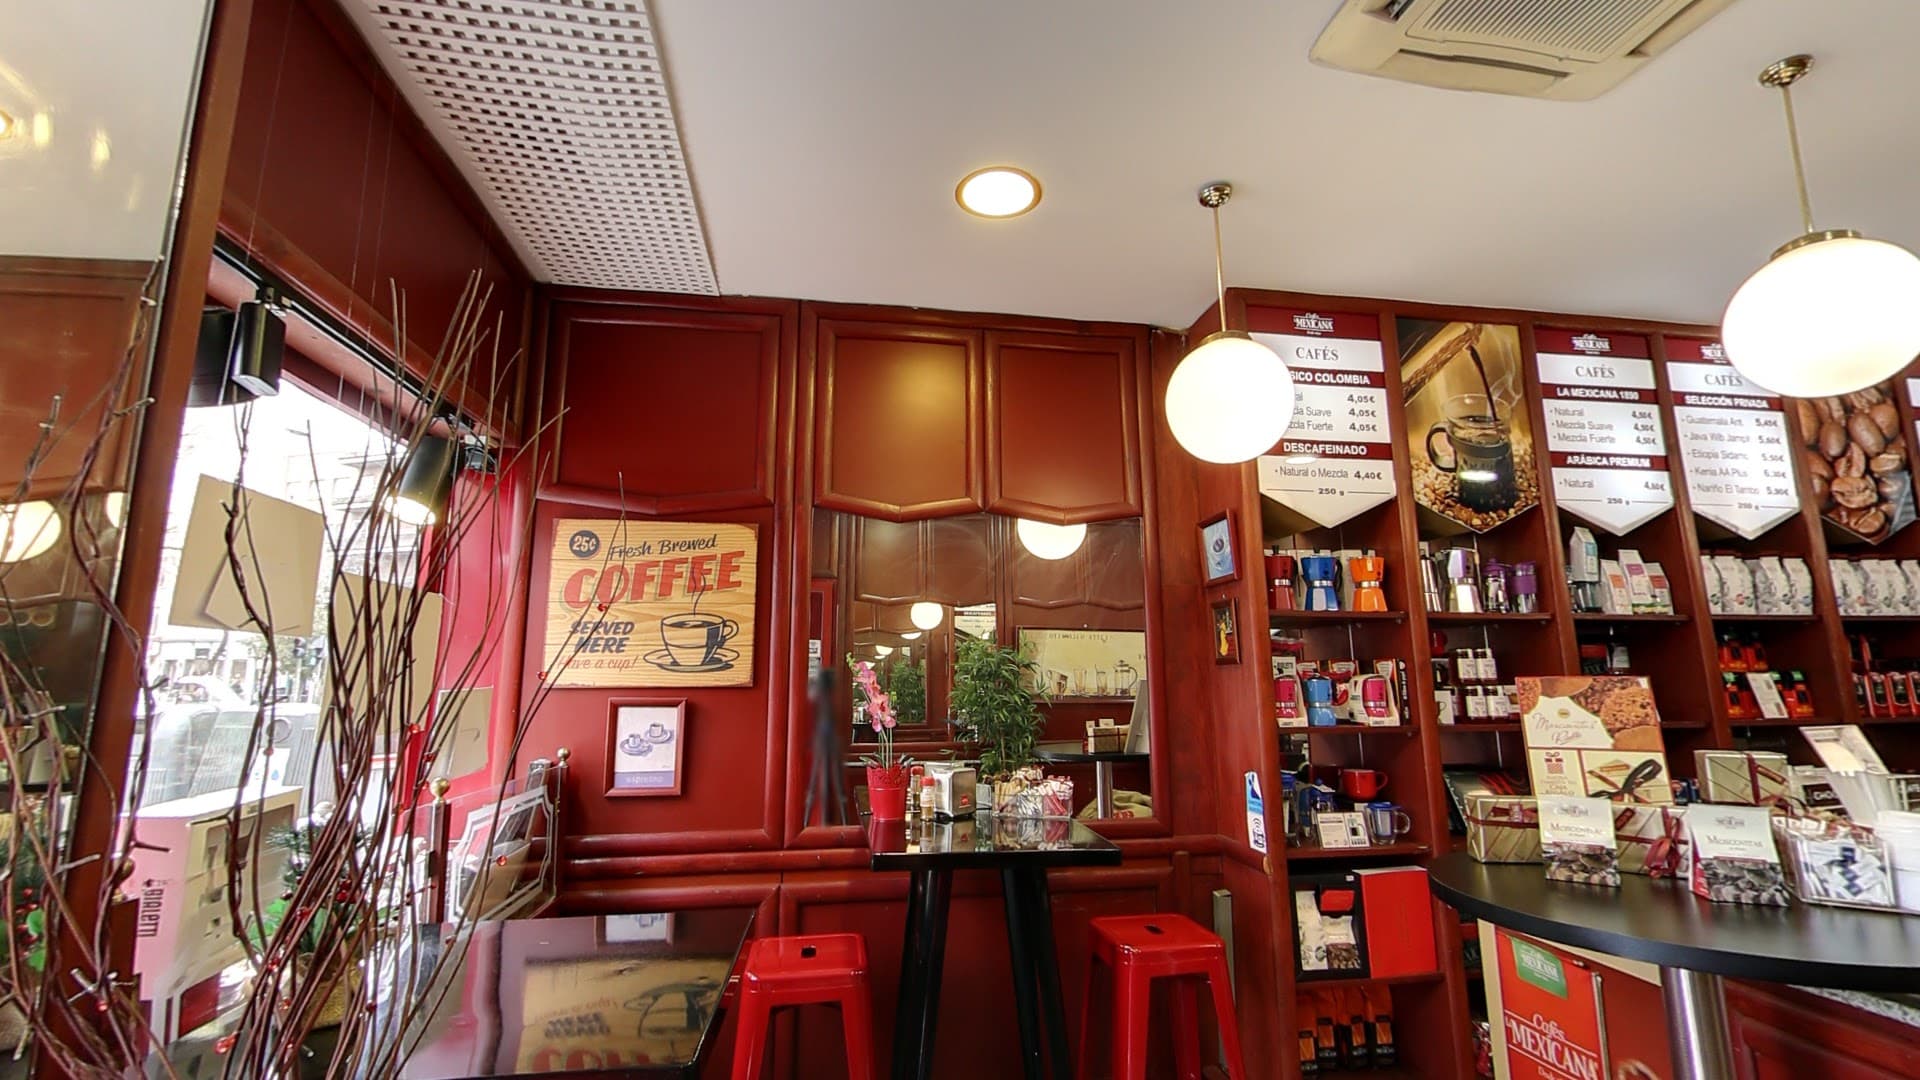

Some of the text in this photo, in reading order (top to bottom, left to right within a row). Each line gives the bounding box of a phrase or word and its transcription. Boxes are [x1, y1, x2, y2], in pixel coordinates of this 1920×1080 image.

[1296, 346, 1339, 361] CAFÉS
[1575, 364, 1615, 378] CAFÉS
[1315, 373, 1370, 385] COLOMBIA
[1704, 372, 1743, 387] CAFÉS
[1347, 394, 1375, 404] 4,05€
[1557, 387, 1570, 396] LA
[1571, 388, 1619, 399] MEXICANA
[1306, 407, 1332, 417] Suave
[1348, 408, 1376, 418] 4,05€
[1307, 421, 1333, 431] Fuerte
[1349, 422, 1377, 432] 4,05€
[1283, 442, 1367, 455] DESCAFEINADO
[1566, 454, 1609, 465] ARÁBICA
[1280, 466, 1308, 477] Natural
[1318, 468, 1348, 478] Mezcla
[1354, 471, 1382, 480] 4,40€
[572, 535, 597, 552] 25¢
[610, 534, 718, 560] Fresh Brewed
[562, 550, 746, 611] COFFEE
[570, 620, 635, 635] SERVED
[575, 636, 630, 653] HERE
[556, 655, 639, 672] Have a cup!
[1532, 1013, 1566, 1041] Cafés
[1510, 1019, 1599, 1080] MEXICANA
